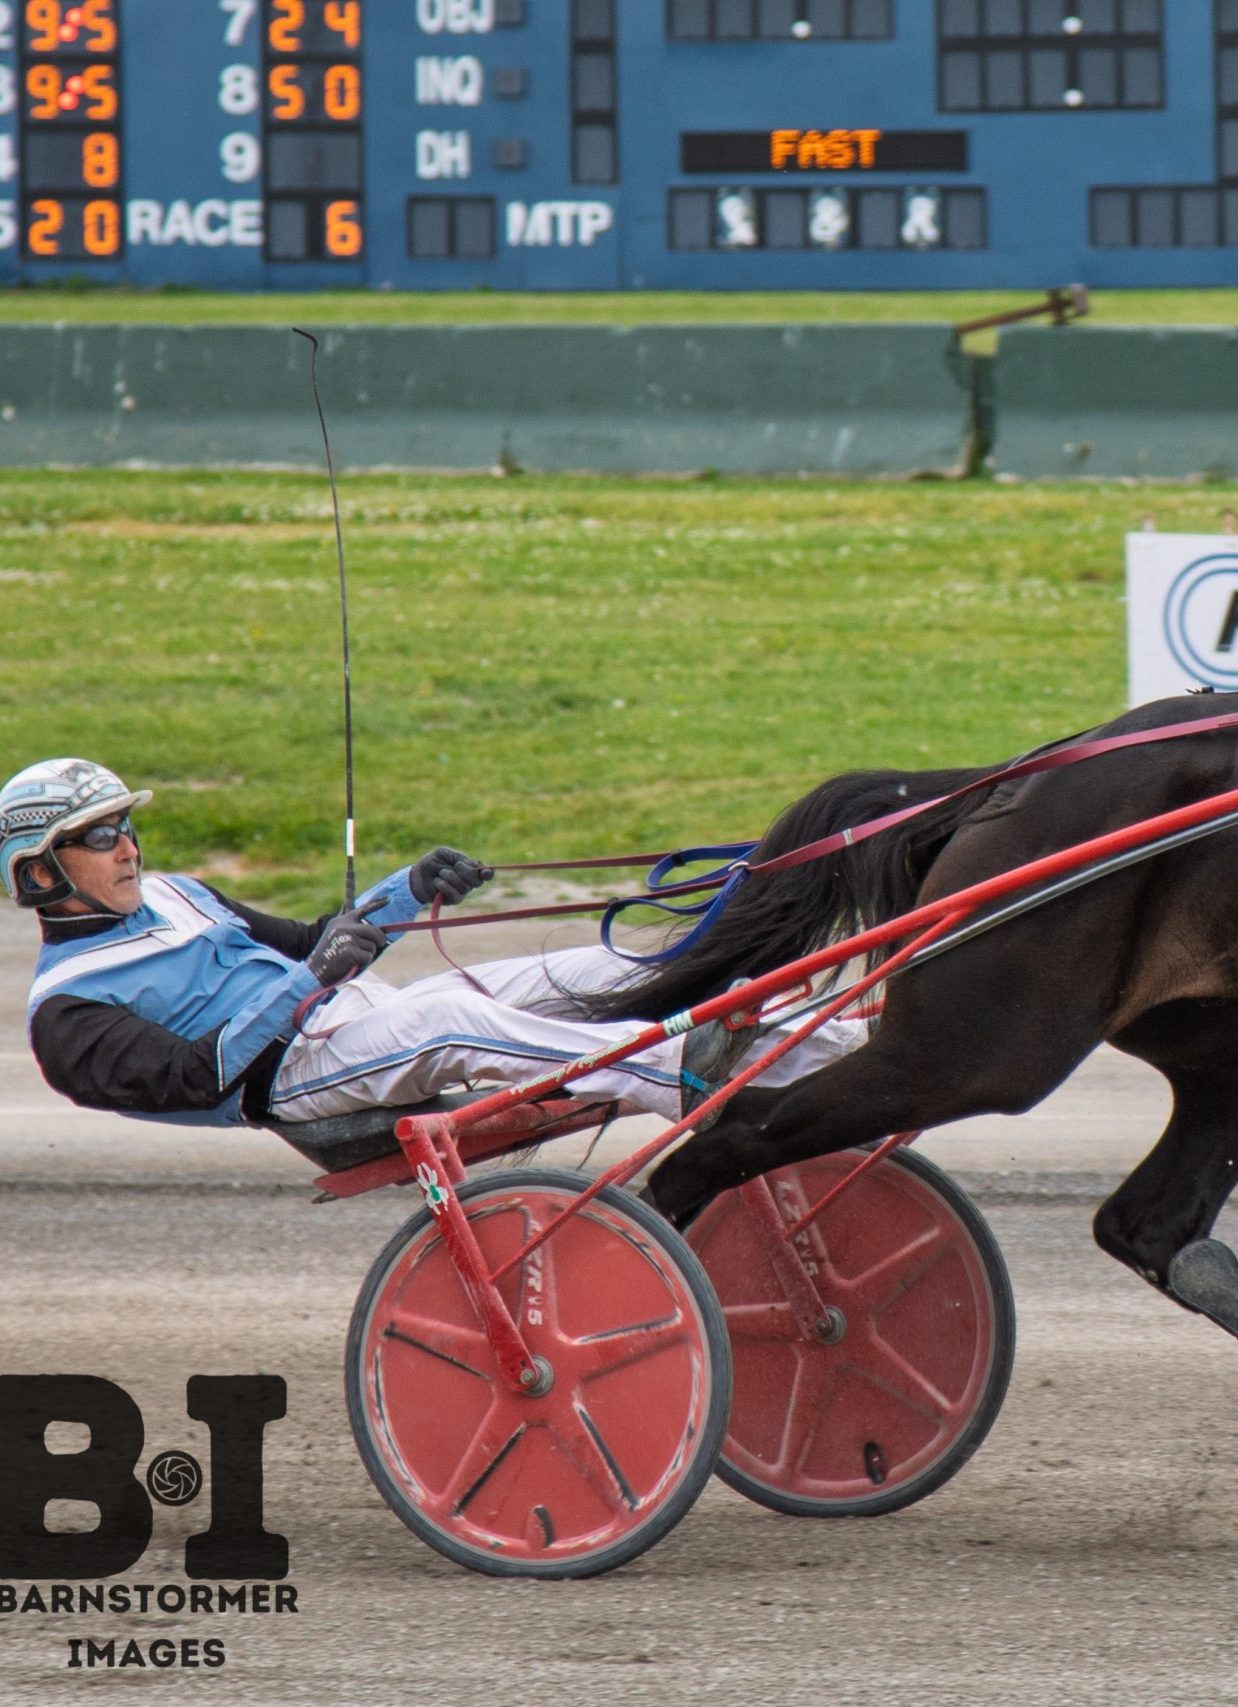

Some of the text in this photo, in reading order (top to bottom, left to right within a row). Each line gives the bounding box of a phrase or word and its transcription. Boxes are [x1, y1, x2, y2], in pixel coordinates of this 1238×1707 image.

[220, 0, 257, 46] 7
[417, 0, 494, 34] OBJ
[219, 65, 261, 115] 8
[416, 56, 484, 106] INQ
[83, 132, 118, 188] 8
[220, 132, 261, 183] 9
[416, 130, 470, 180] DH
[770, 129, 881, 169] FAST
[126, 200, 264, 246] RACE
[325, 201, 362, 256] 6
[506, 201, 613, 247] MTP
